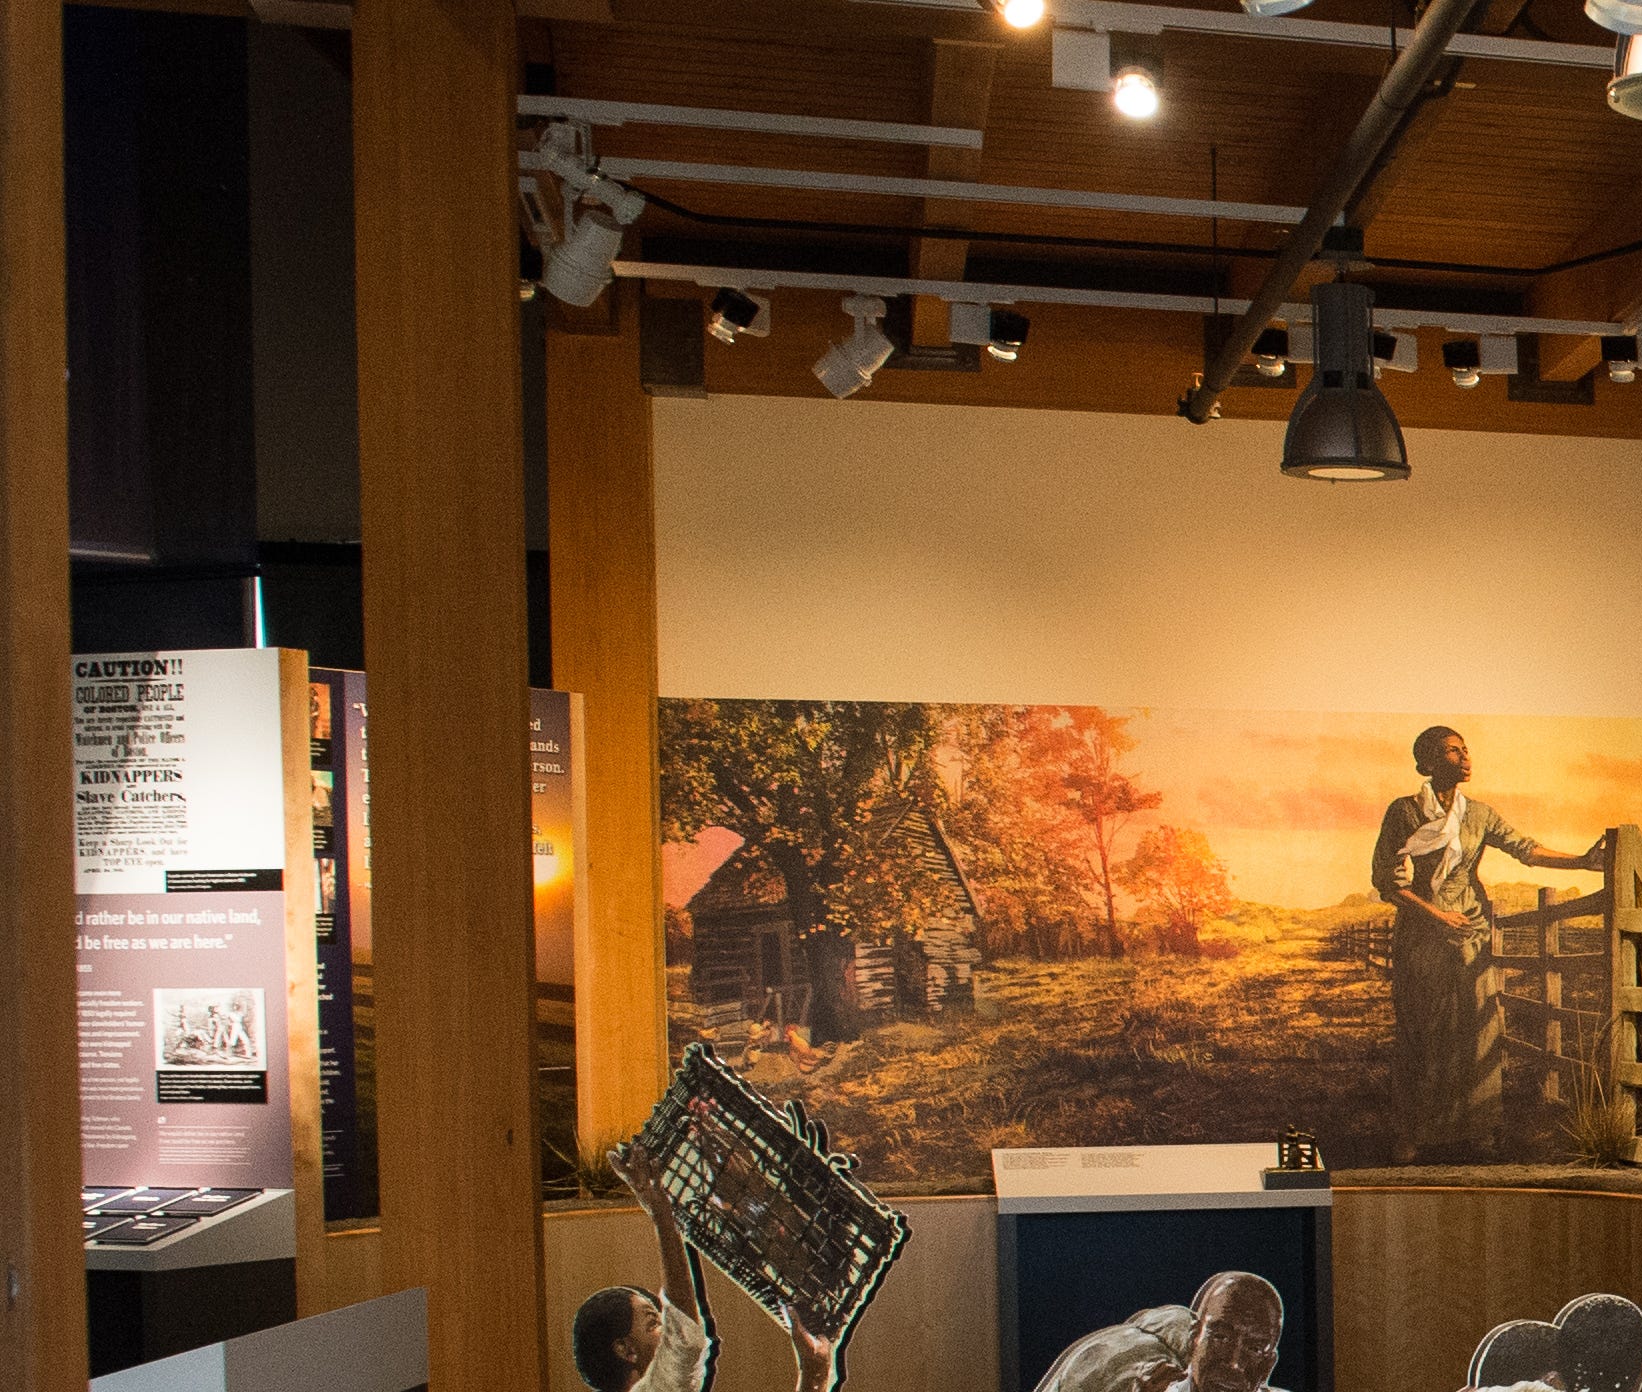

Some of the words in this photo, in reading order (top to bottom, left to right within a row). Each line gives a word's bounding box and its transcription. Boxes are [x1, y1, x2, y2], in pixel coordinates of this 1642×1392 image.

[75, 658, 183, 679] CAUTION!!
[76, 685, 129, 704] COLORED
[137, 682, 184, 704] PEOPLE
[80, 768, 182, 785] KIDNAPPERS
[76, 791, 115, 804] Slave
[86, 909, 125, 928] rather
[128, 910, 144, 925] be
[147, 910, 158, 924] in
[162, 914, 184, 924] our
[186, 910, 225, 924] native
[229, 909, 261, 925] land,
[85, 936, 101, 950] be
[104, 935, 128, 949] free
[131, 939, 146, 949] as
[149, 939, 167, 949] we
[170, 938, 192, 949] are
